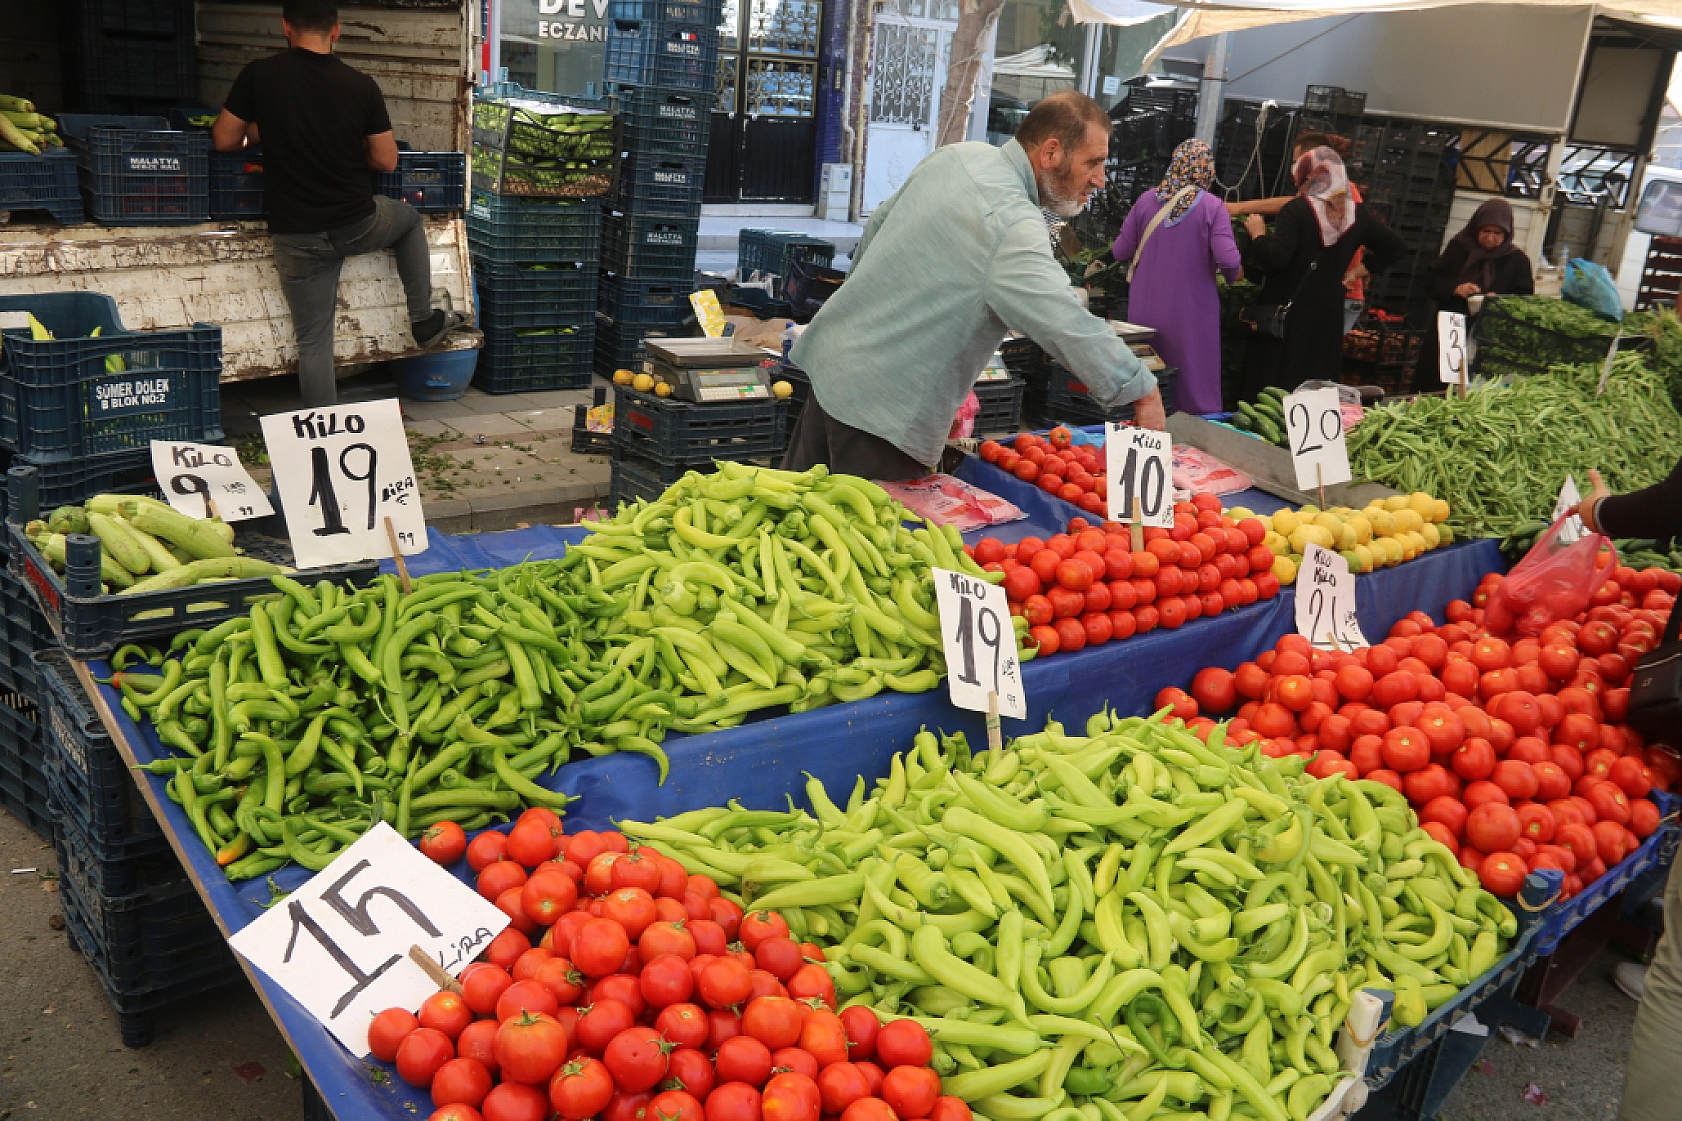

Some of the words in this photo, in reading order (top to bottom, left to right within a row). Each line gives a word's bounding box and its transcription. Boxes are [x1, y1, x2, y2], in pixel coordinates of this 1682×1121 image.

[538, 20, 609, 42] ECZAN
[102, 399, 109, 410] B
[112, 395, 140, 408] BLOK
[142, 393, 166, 405] NO:2
[1289, 403, 1341, 456] 20
[170, 473, 212, 518] 9
[309, 443, 377, 536] 19
[1117, 448, 1165, 518] 10
[956, 596, 1001, 697] 19
[282, 859, 444, 1020] 15
